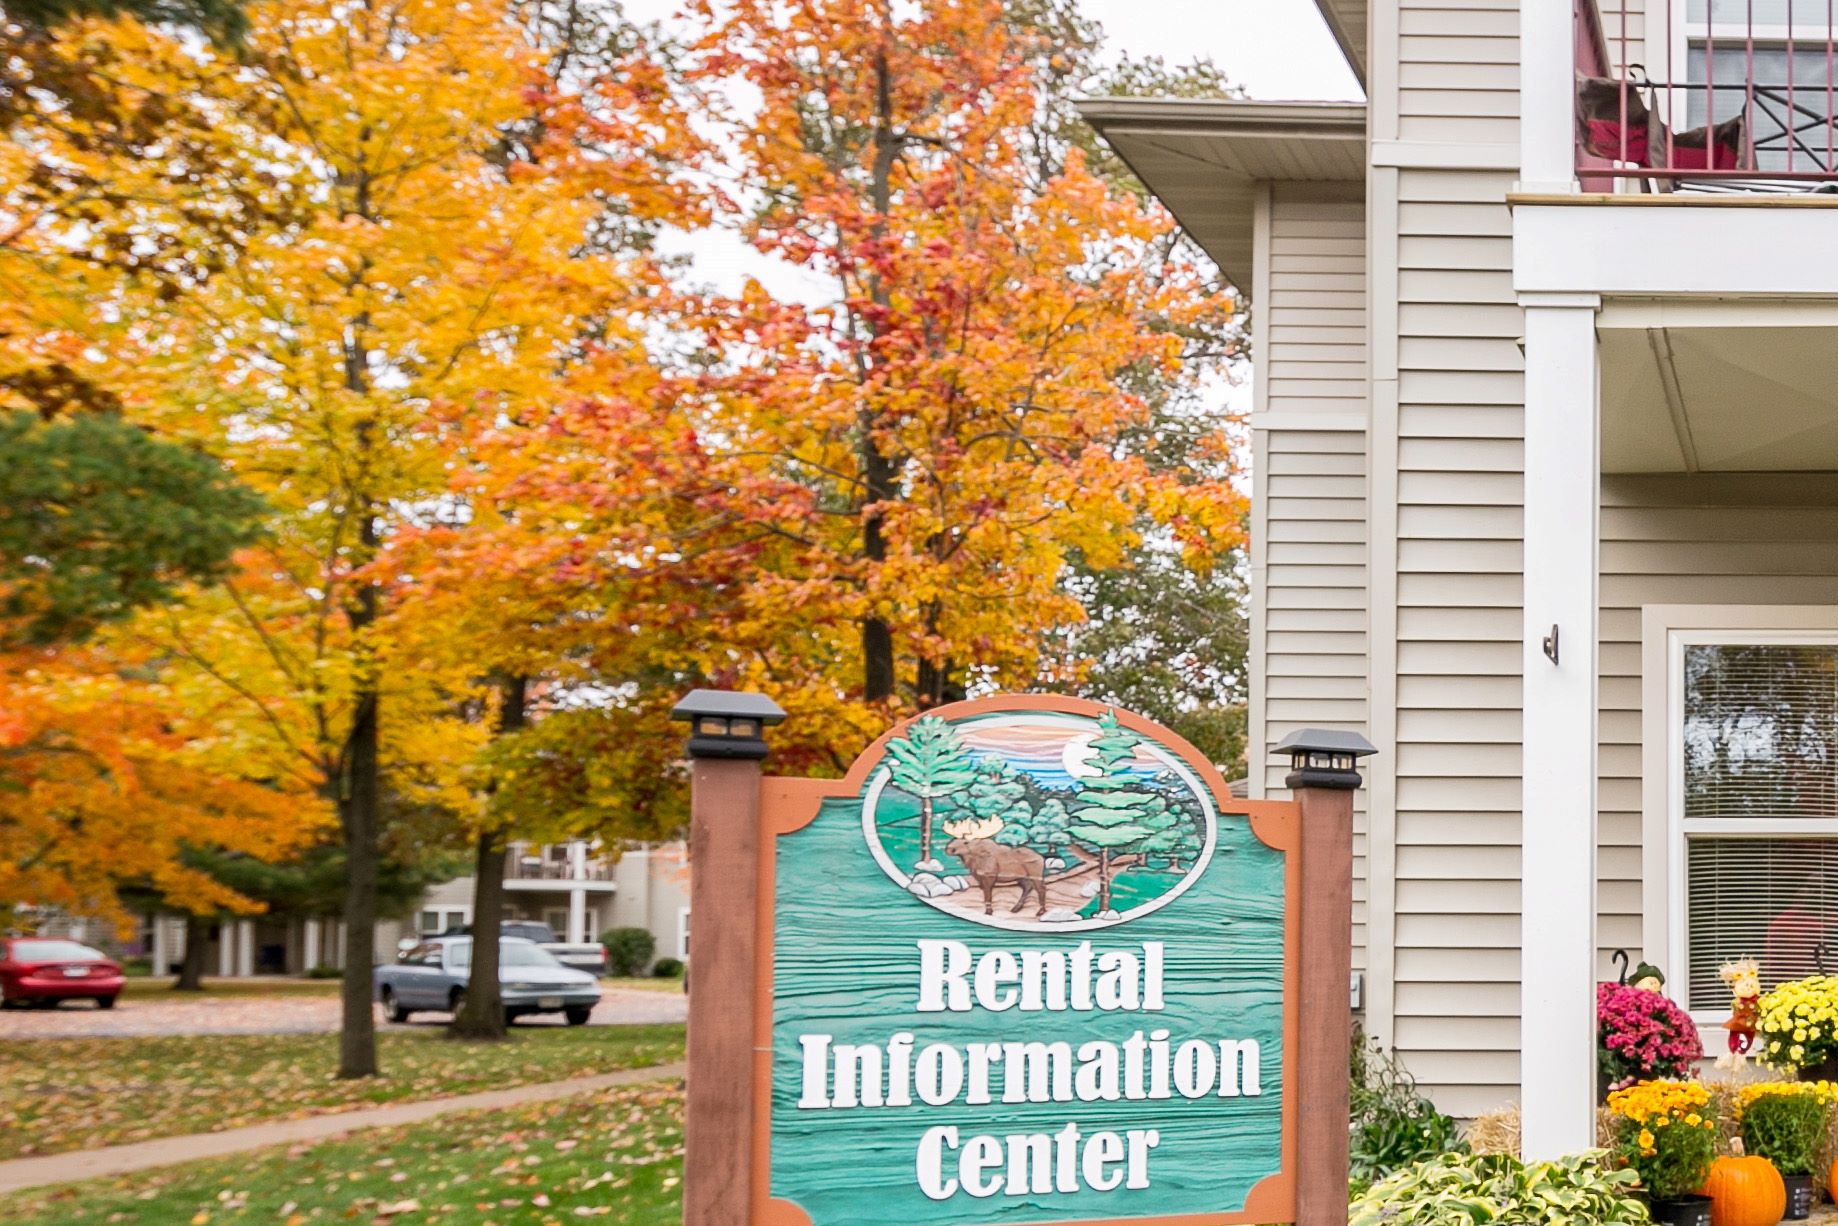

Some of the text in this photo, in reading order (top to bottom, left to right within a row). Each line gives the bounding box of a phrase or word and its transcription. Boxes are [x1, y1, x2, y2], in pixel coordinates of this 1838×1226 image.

[916, 938, 1166, 1012] Rental
[797, 1027, 1262, 1109] Information
[916, 1122, 1160, 1200] Center
